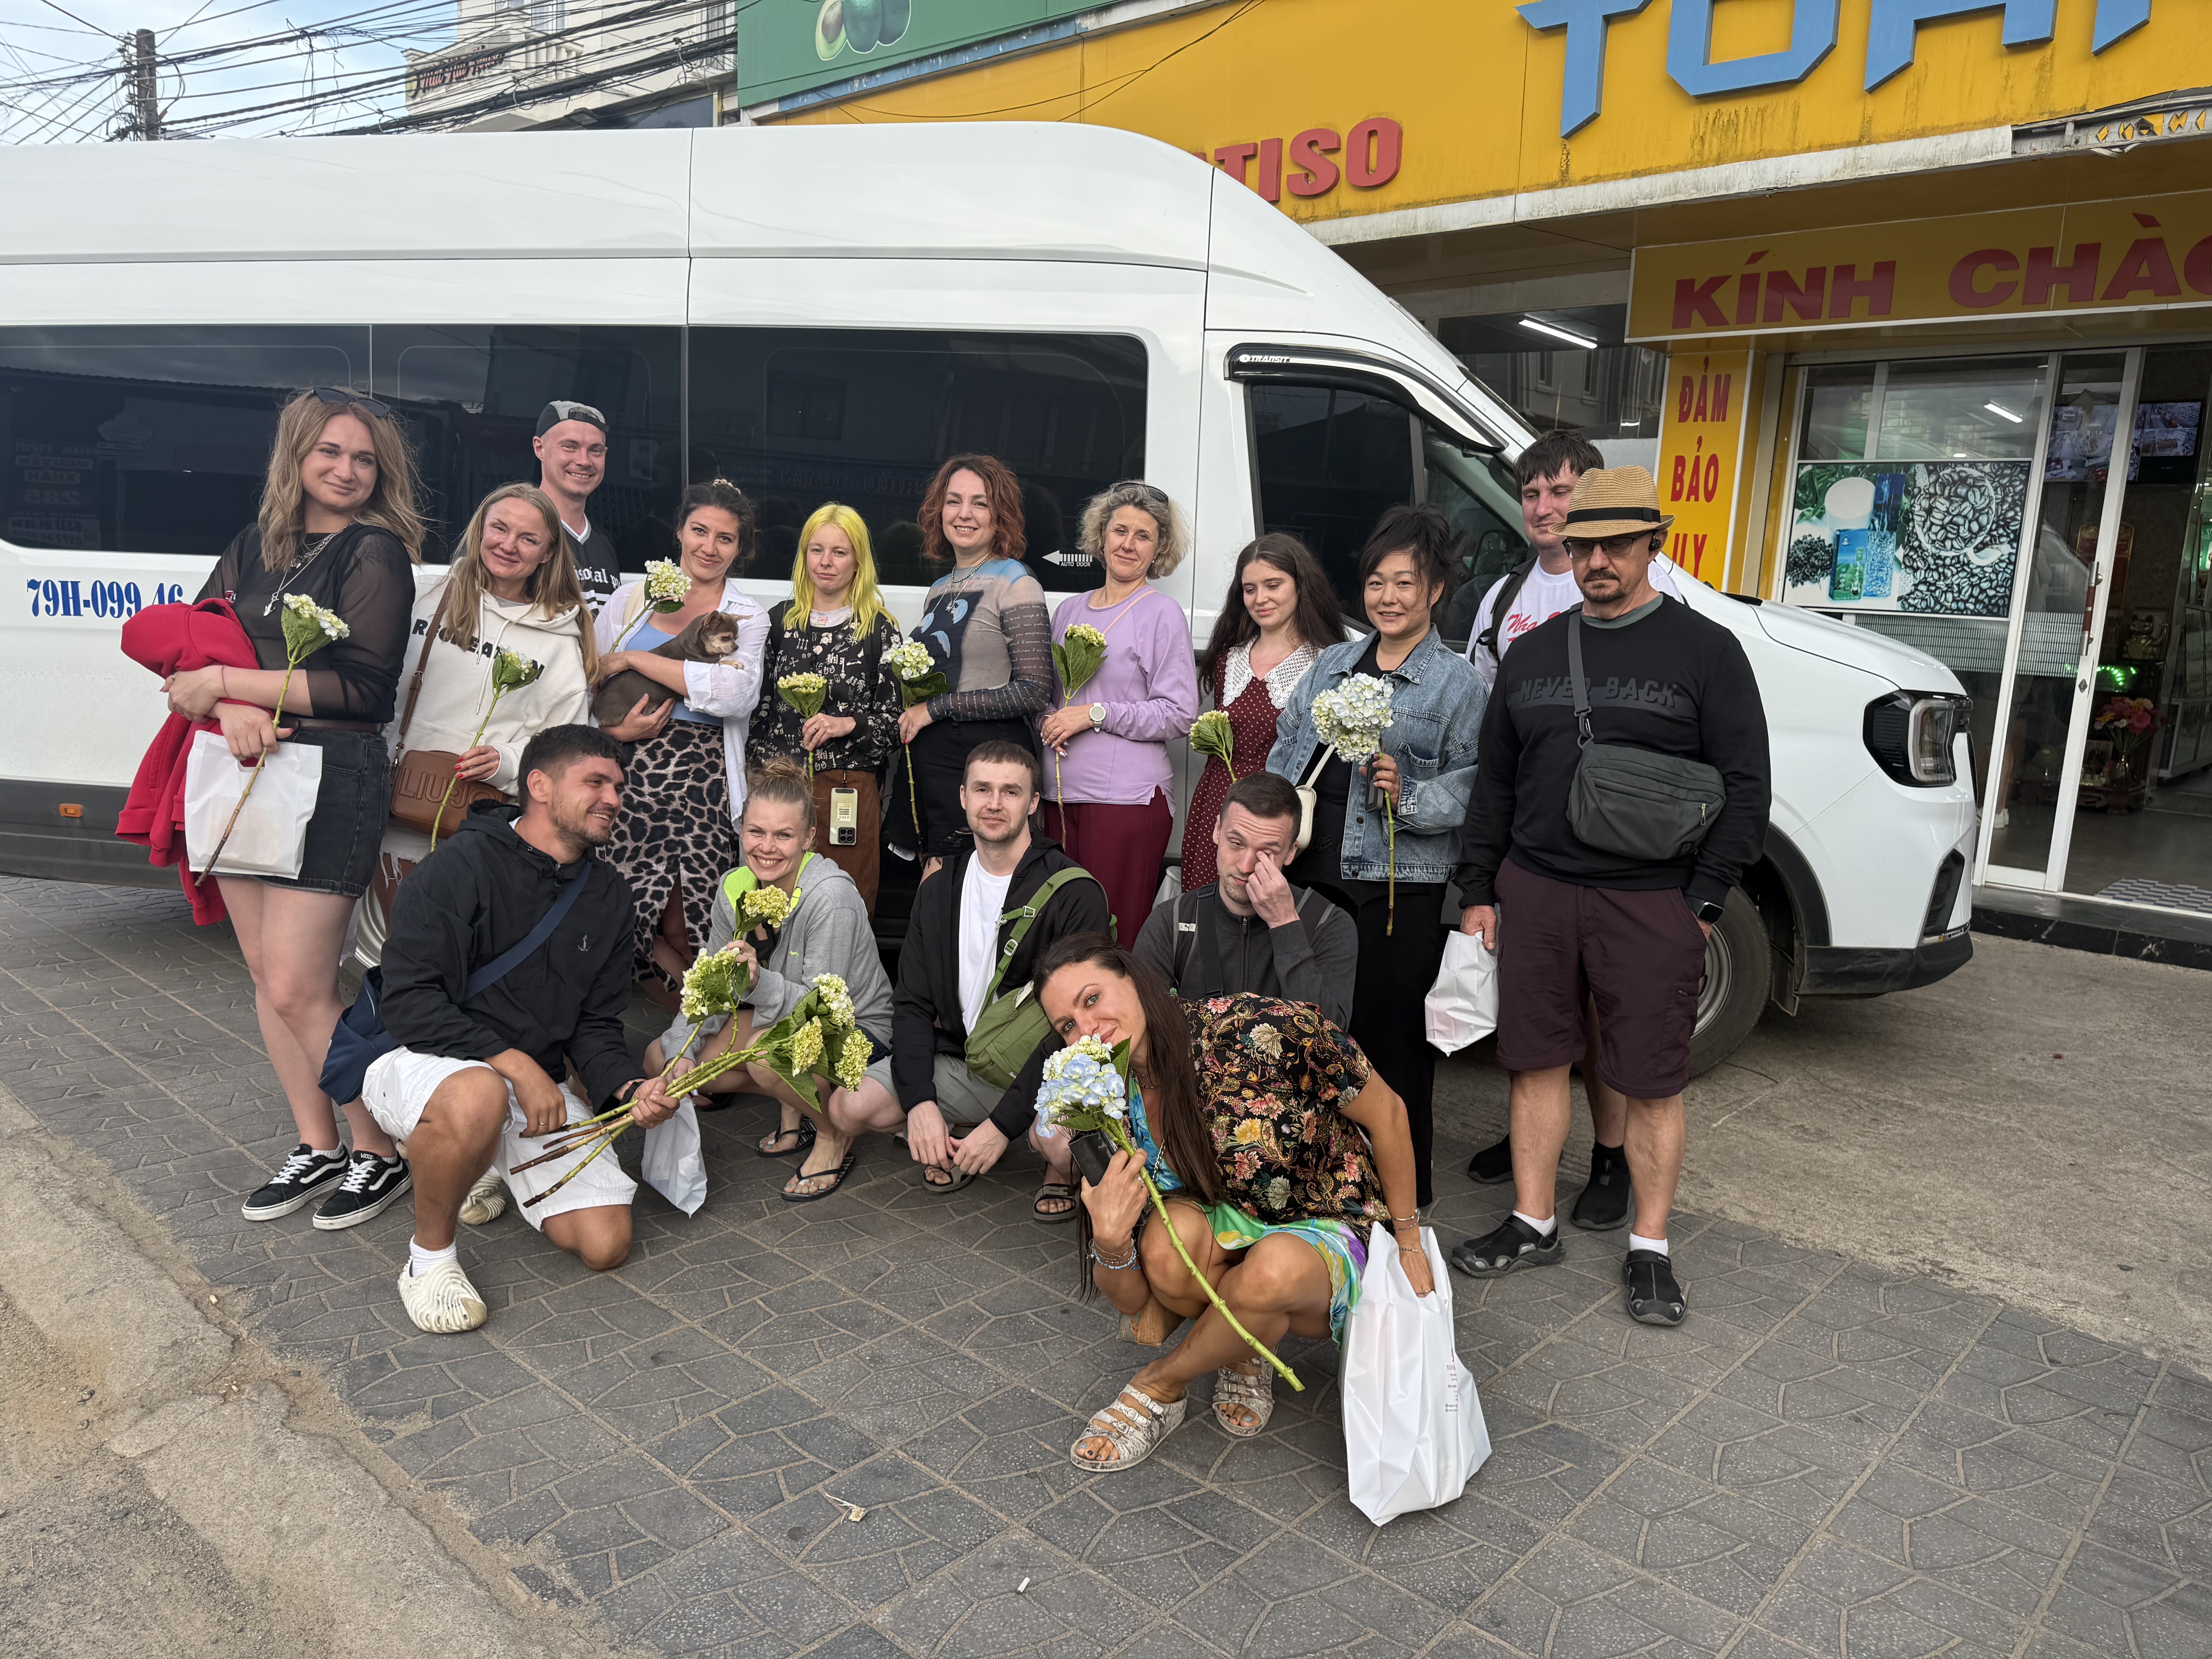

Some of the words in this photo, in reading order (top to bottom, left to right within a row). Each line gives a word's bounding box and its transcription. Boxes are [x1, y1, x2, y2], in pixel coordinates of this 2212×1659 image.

[1191, 117, 1403, 203] TISO
[1671, 250, 1896, 329] KÍNH
[1250, 355, 1290, 363] TRANSIT
[1678, 356, 1731, 422] ĐẢM
[1670, 435, 1719, 503] BẢO
[1520, 677, 1591, 702] NEVE
[1606, 677, 1676, 708] BACK
